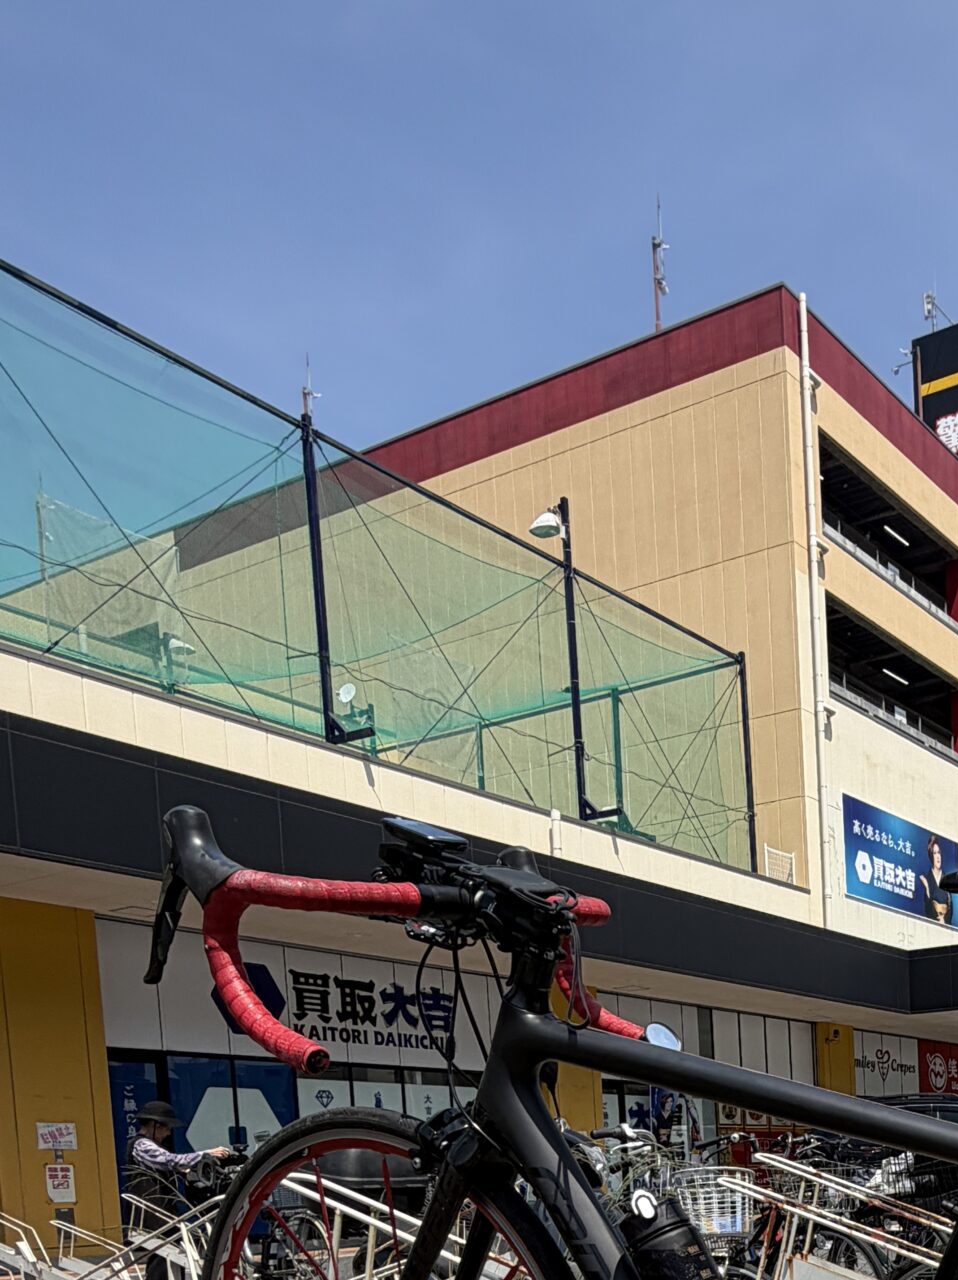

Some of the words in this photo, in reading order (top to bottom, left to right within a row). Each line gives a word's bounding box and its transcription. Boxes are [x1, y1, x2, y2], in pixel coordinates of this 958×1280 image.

[288, 969, 454, 1034] 買取大吉
[293, 1023, 368, 1045] KAITORI
[891, 1058, 916, 1076] Crepes
